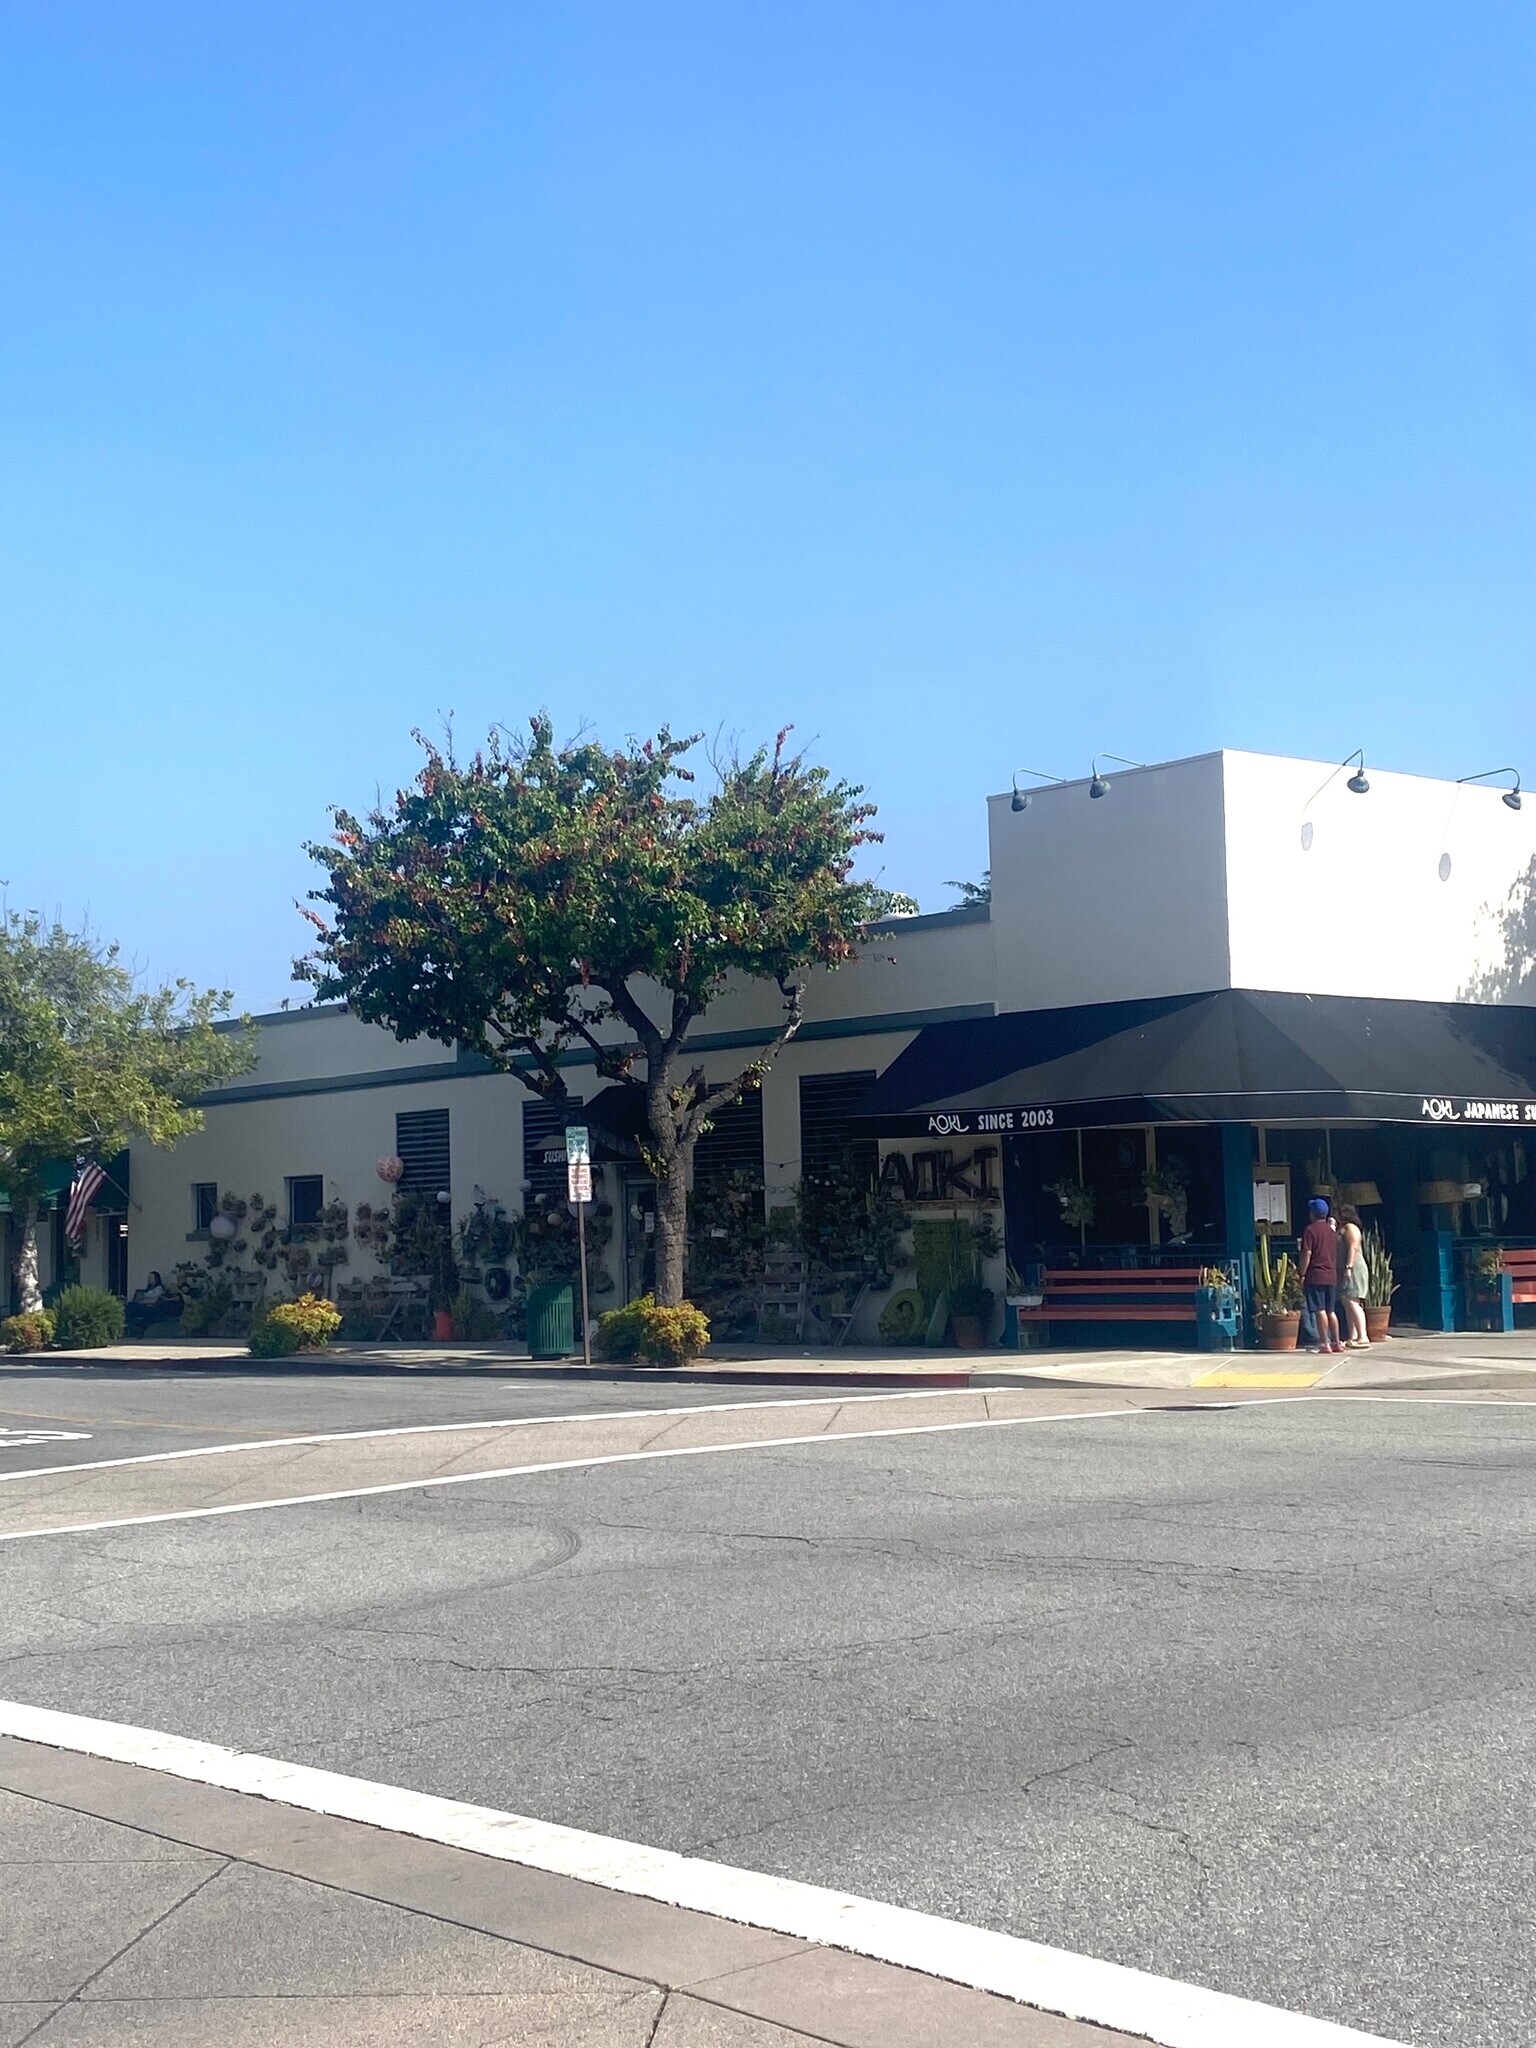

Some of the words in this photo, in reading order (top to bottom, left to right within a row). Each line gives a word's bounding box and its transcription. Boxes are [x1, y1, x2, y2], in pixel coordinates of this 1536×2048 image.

[1421, 1098, 1461, 1121] AOKI
[1464, 1101, 1520, 1121] JAPANESE
[928, 1114, 969, 1134] AOKI
[977, 1112, 1014, 1131] SINCE
[1021, 1109, 1055, 1128] 2003
[543, 1150, 566, 1164] SUSHI
